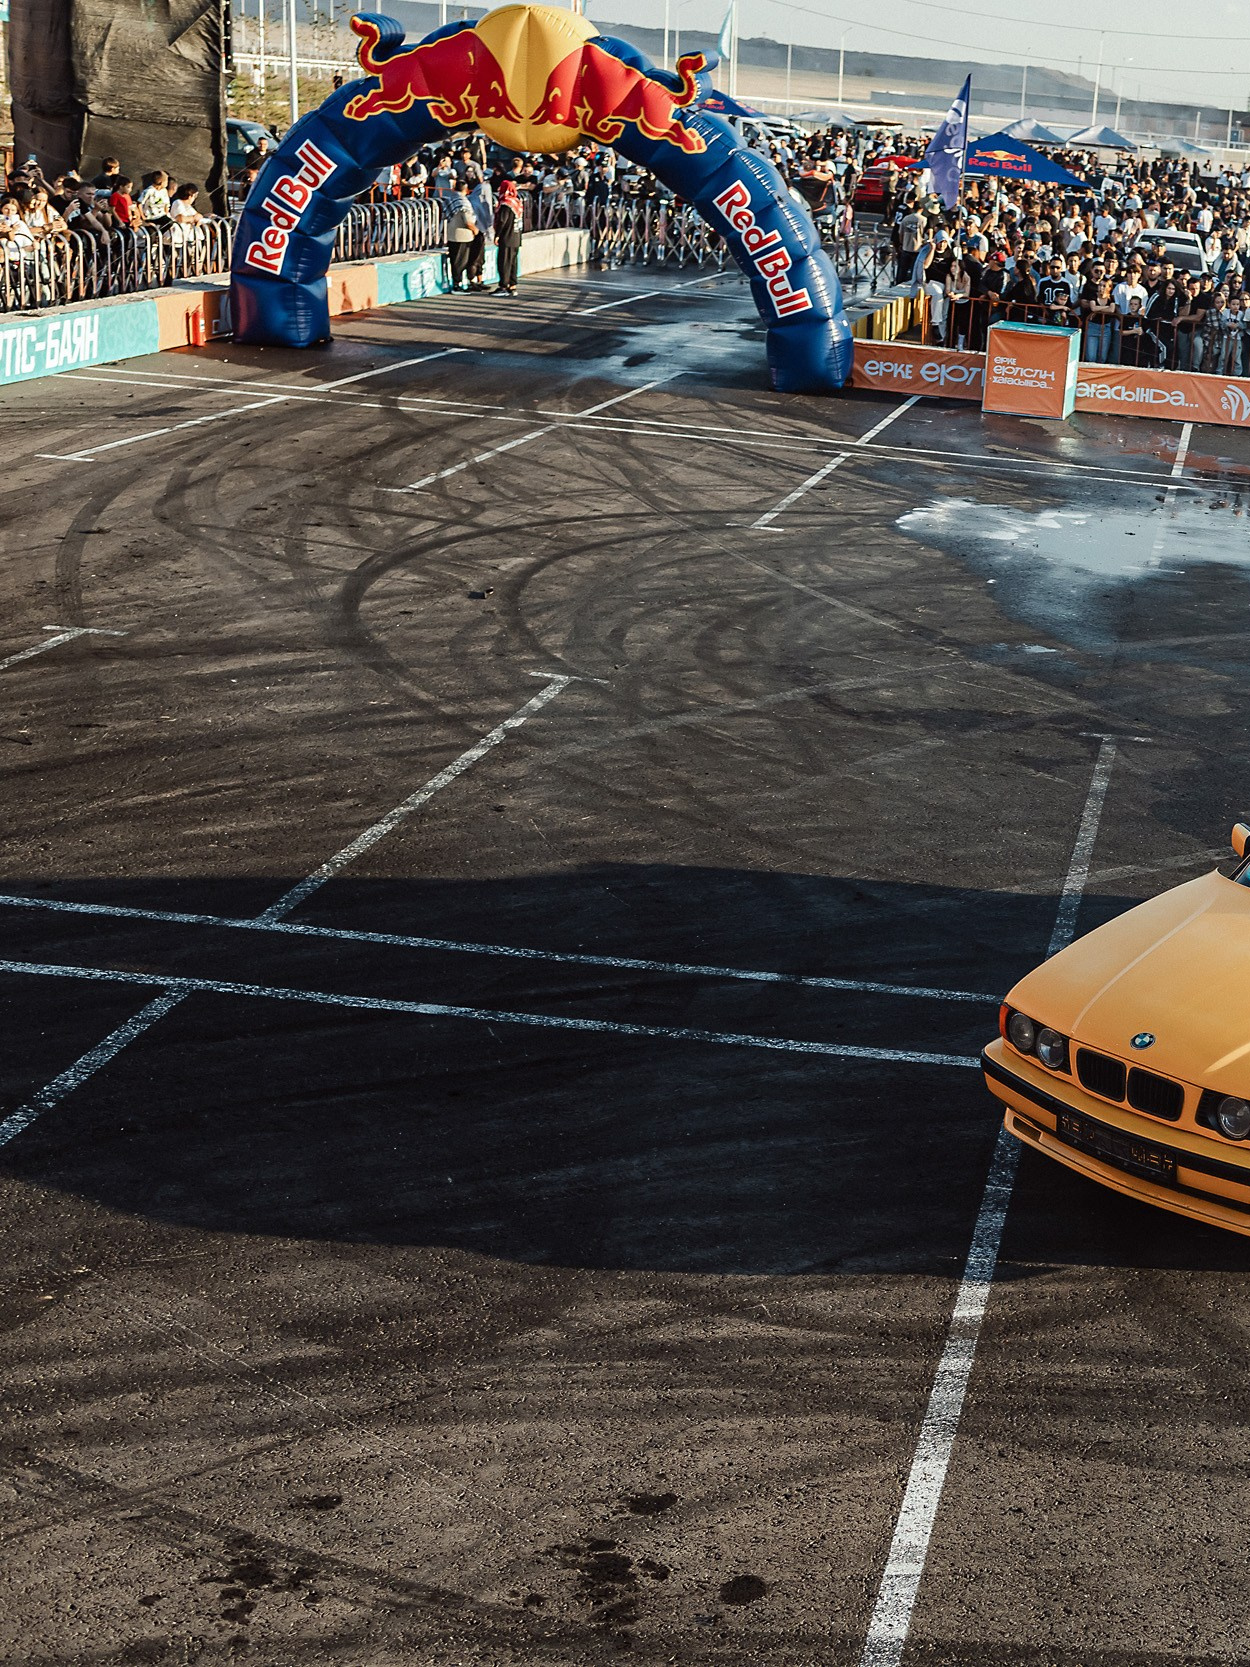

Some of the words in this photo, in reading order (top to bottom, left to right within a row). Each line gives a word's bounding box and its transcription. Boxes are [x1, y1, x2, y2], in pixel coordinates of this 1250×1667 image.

[270, 139, 338, 214] Bull
[968, 157, 1000, 168] Red
[1001, 161, 1032, 172] Bull
[245, 198, 301, 276] Red
[712, 180, 782, 256] Red
[754, 245, 814, 318] Bull
[1076, 382, 1199, 408] ағасында...
